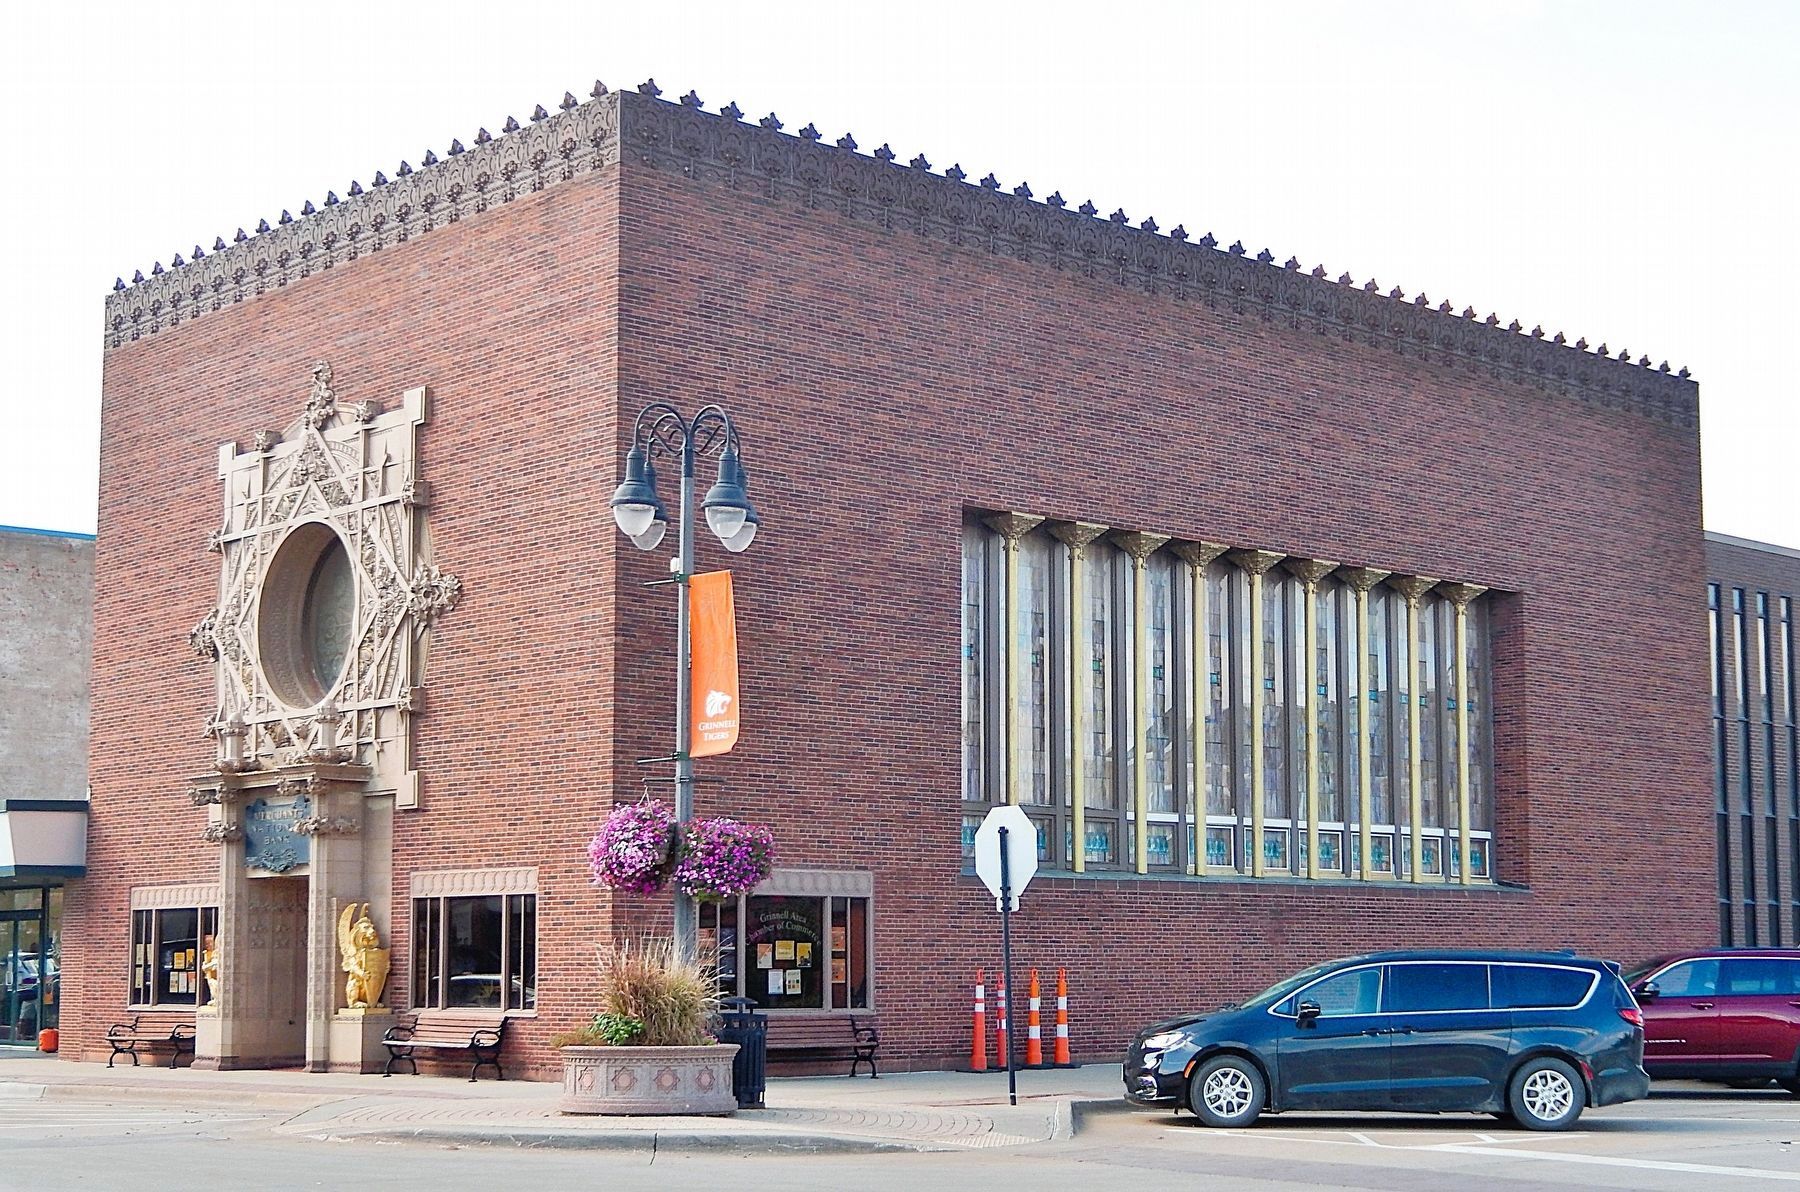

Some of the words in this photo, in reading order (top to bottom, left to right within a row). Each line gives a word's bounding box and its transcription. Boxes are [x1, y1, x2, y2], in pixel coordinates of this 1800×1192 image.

[698, 720, 737, 731] GRINNELL
[264, 835, 290, 846] BANK
[760, 911, 789, 922] Grinnell
[791, 912, 807, 923] Area
[776, 921, 785, 930] of
[785, 921, 821, 945] Commerce
